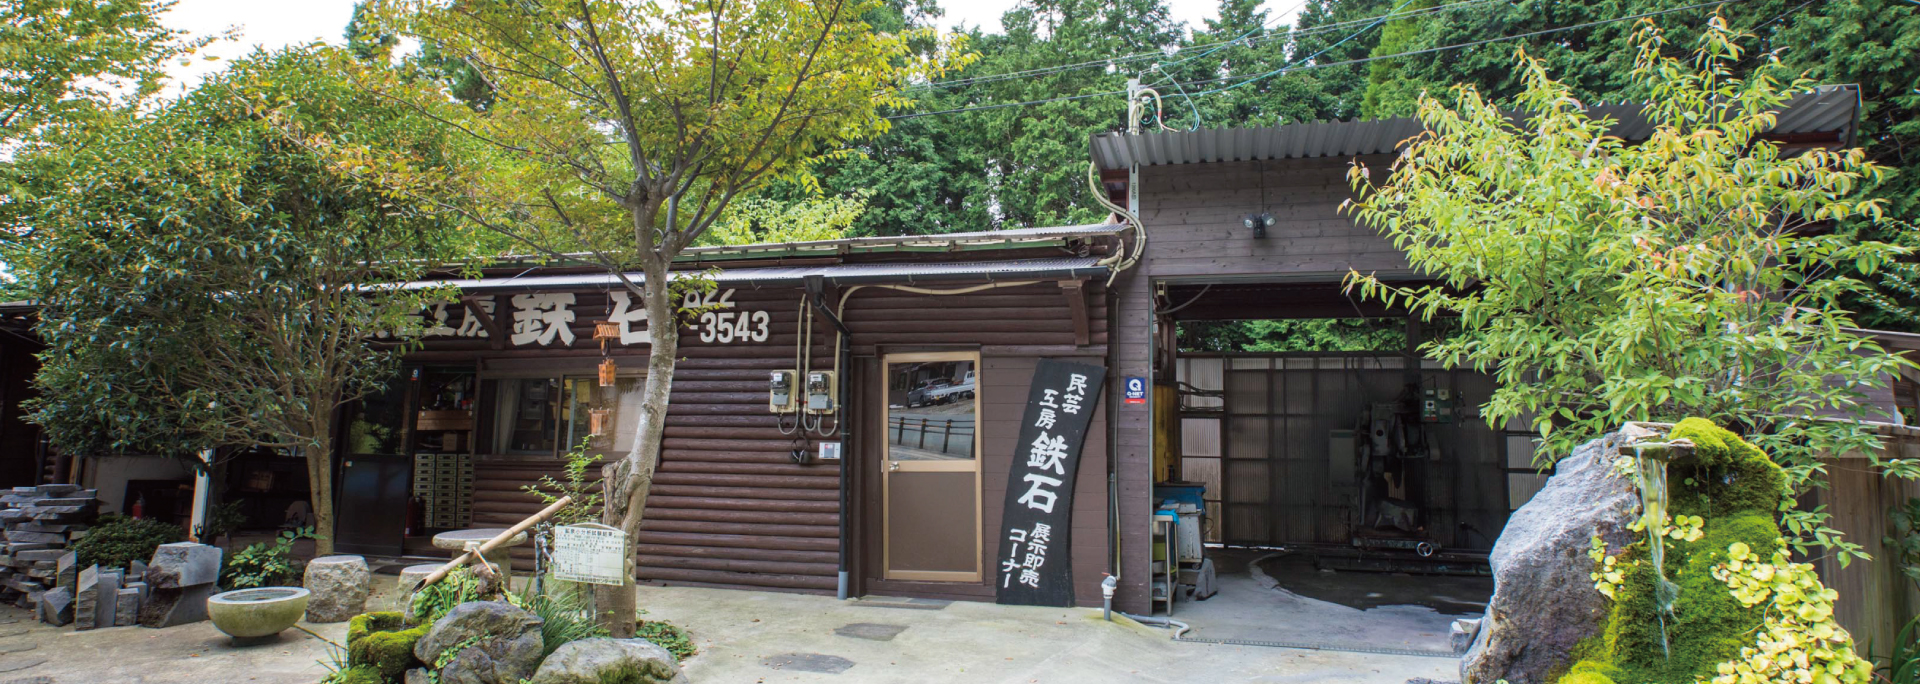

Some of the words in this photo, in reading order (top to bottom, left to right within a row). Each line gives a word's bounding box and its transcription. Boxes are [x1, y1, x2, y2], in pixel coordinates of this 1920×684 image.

[688, 310, 770, 344] -3543
[1034, 388, 1059, 430] 工房
[1062, 373, 1088, 415] 民芸
[1017, 430, 1069, 514] 鉄石
[1002, 528, 1028, 589] コーナー
[1019, 522, 1052, 588] 展示即売
